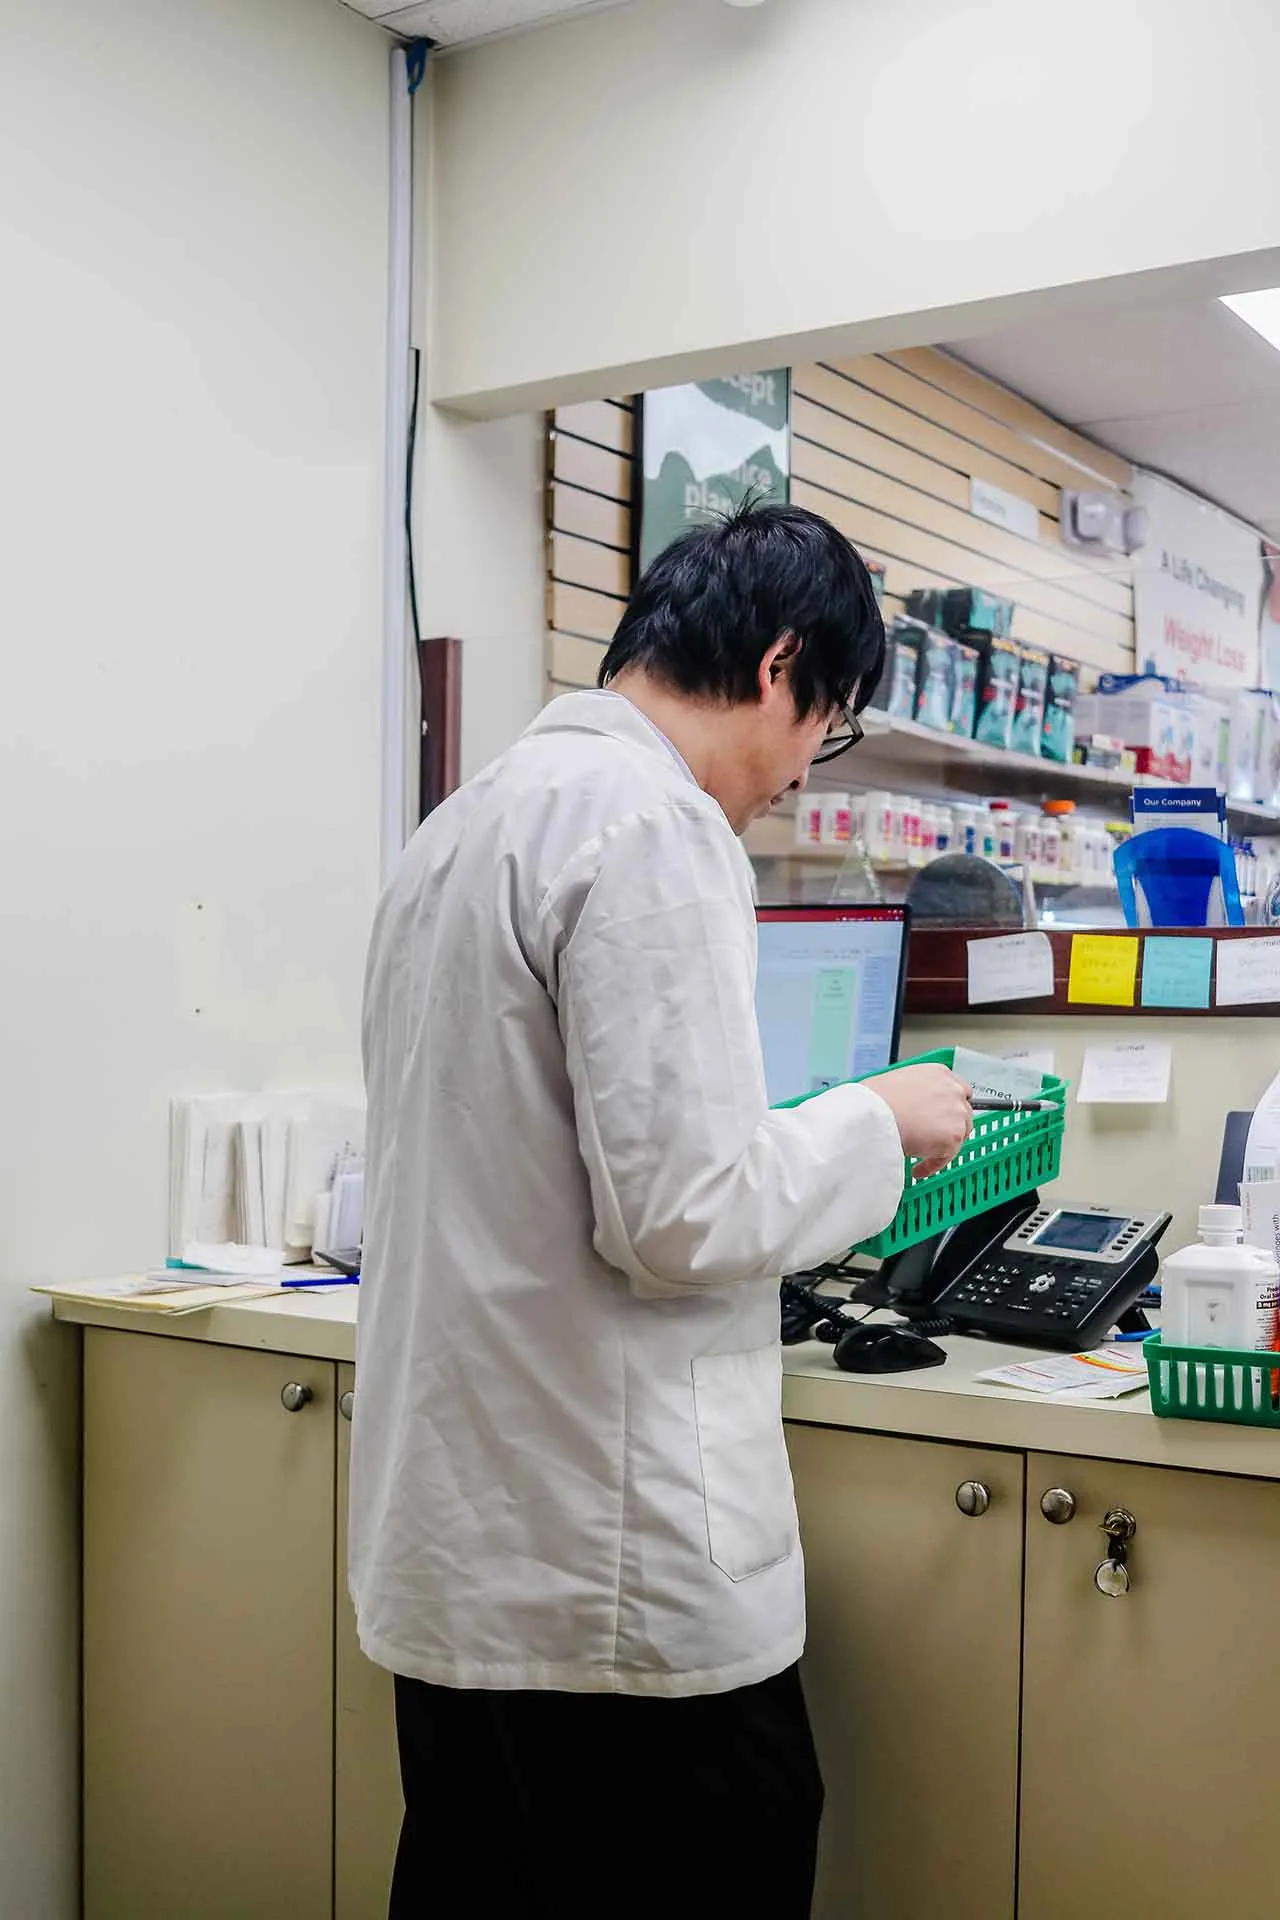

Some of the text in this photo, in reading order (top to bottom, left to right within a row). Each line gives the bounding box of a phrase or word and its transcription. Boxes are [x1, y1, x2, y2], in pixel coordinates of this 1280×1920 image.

[1164, 615, 1214, 664] Weight
[1143, 798, 1202, 808] Our Company
